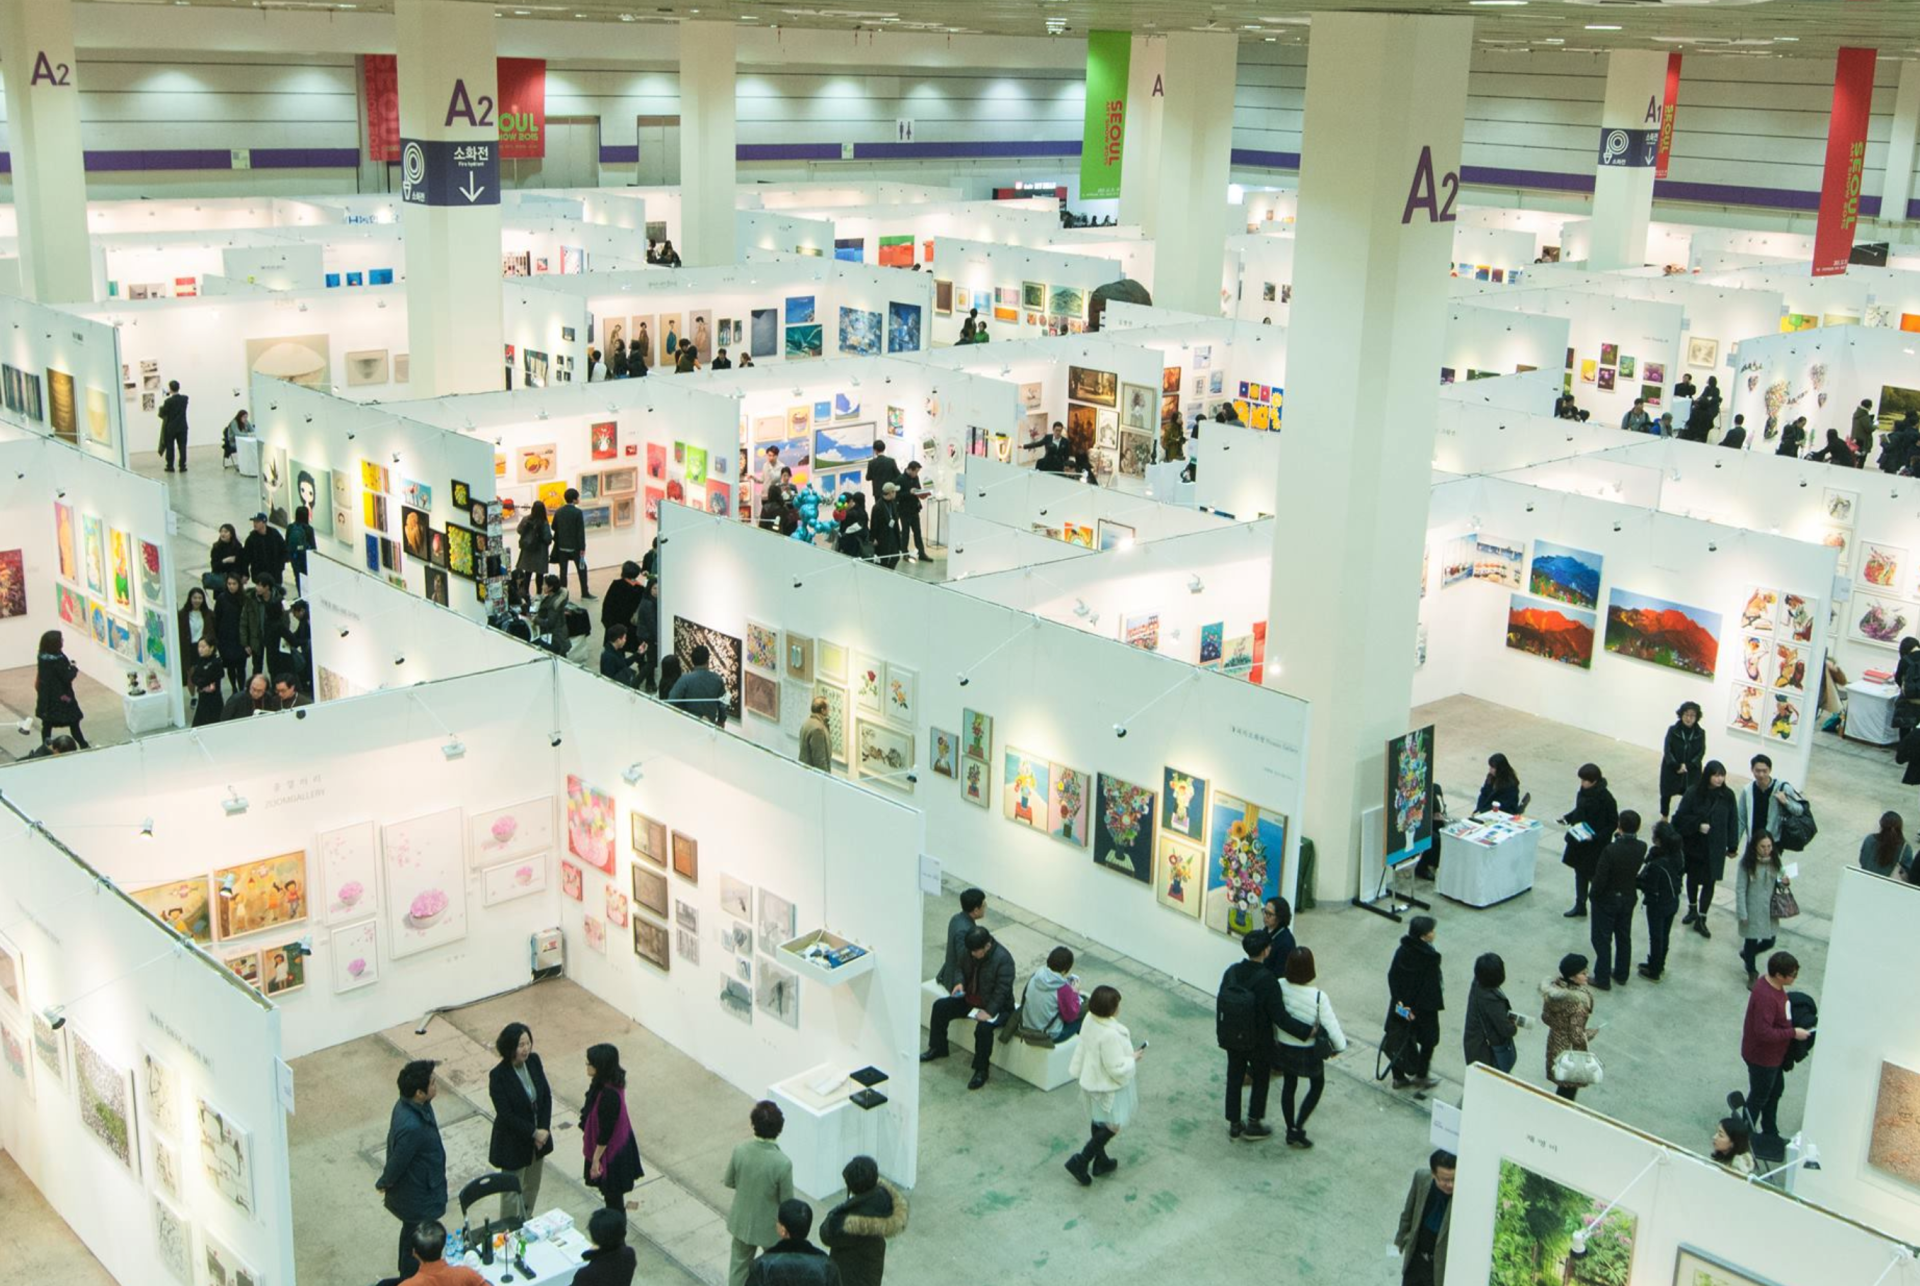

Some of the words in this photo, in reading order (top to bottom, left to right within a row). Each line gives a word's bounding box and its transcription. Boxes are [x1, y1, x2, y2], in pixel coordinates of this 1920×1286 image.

[31, 51, 70, 86] A2
[1152, 73, 1164, 97] A
[445, 79, 494, 127] A2
[498, 112, 539, 132] OUL
[1644, 94, 1662, 123] A1
[1109, 99, 1123, 167] SEOUL
[1659, 104, 1674, 154] SEOUL
[454, 146, 489, 161] 소화전
[1401, 145, 1459, 224] A2
[1844, 141, 1864, 230] SEOUL
